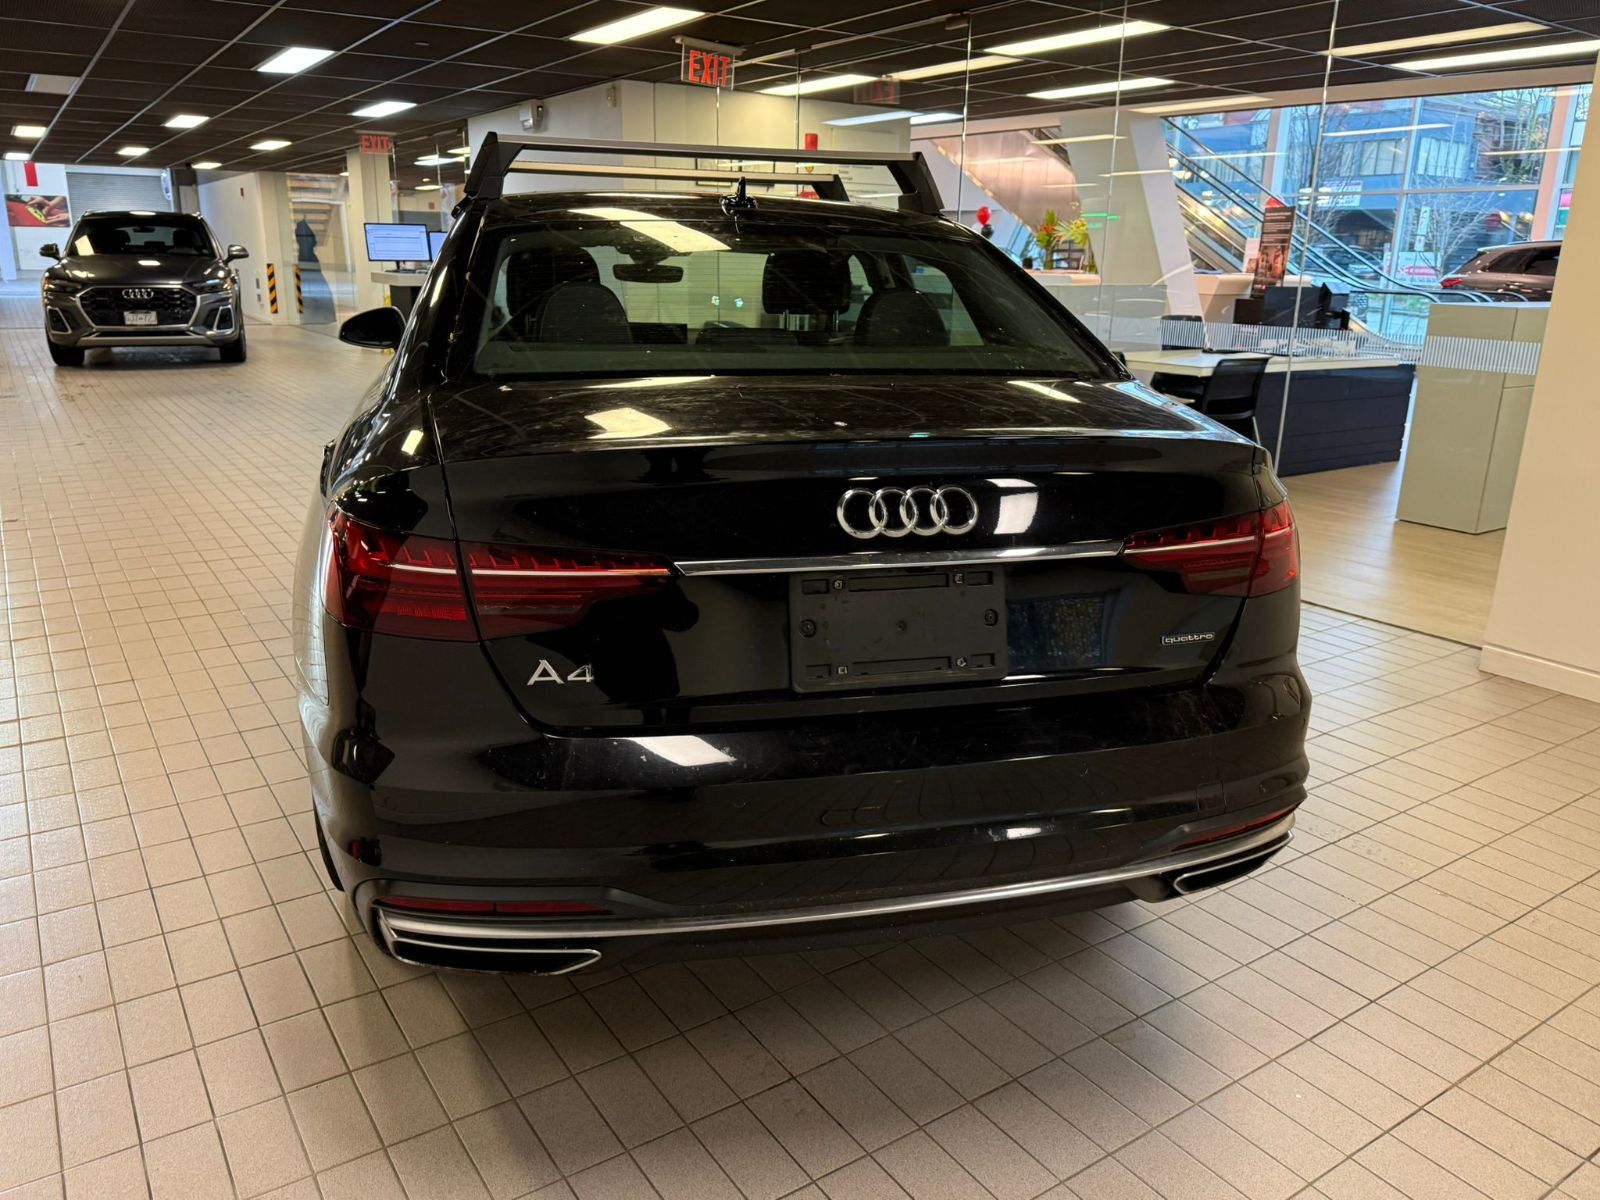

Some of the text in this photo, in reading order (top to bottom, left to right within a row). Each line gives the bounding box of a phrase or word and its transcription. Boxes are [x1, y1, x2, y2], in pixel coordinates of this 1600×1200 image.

[688, 49, 730, 88] EXIT
[360, 135, 389, 153] EXIT
[1163, 633, 1214, 645] quattro
[526, 659, 594, 686] A4
